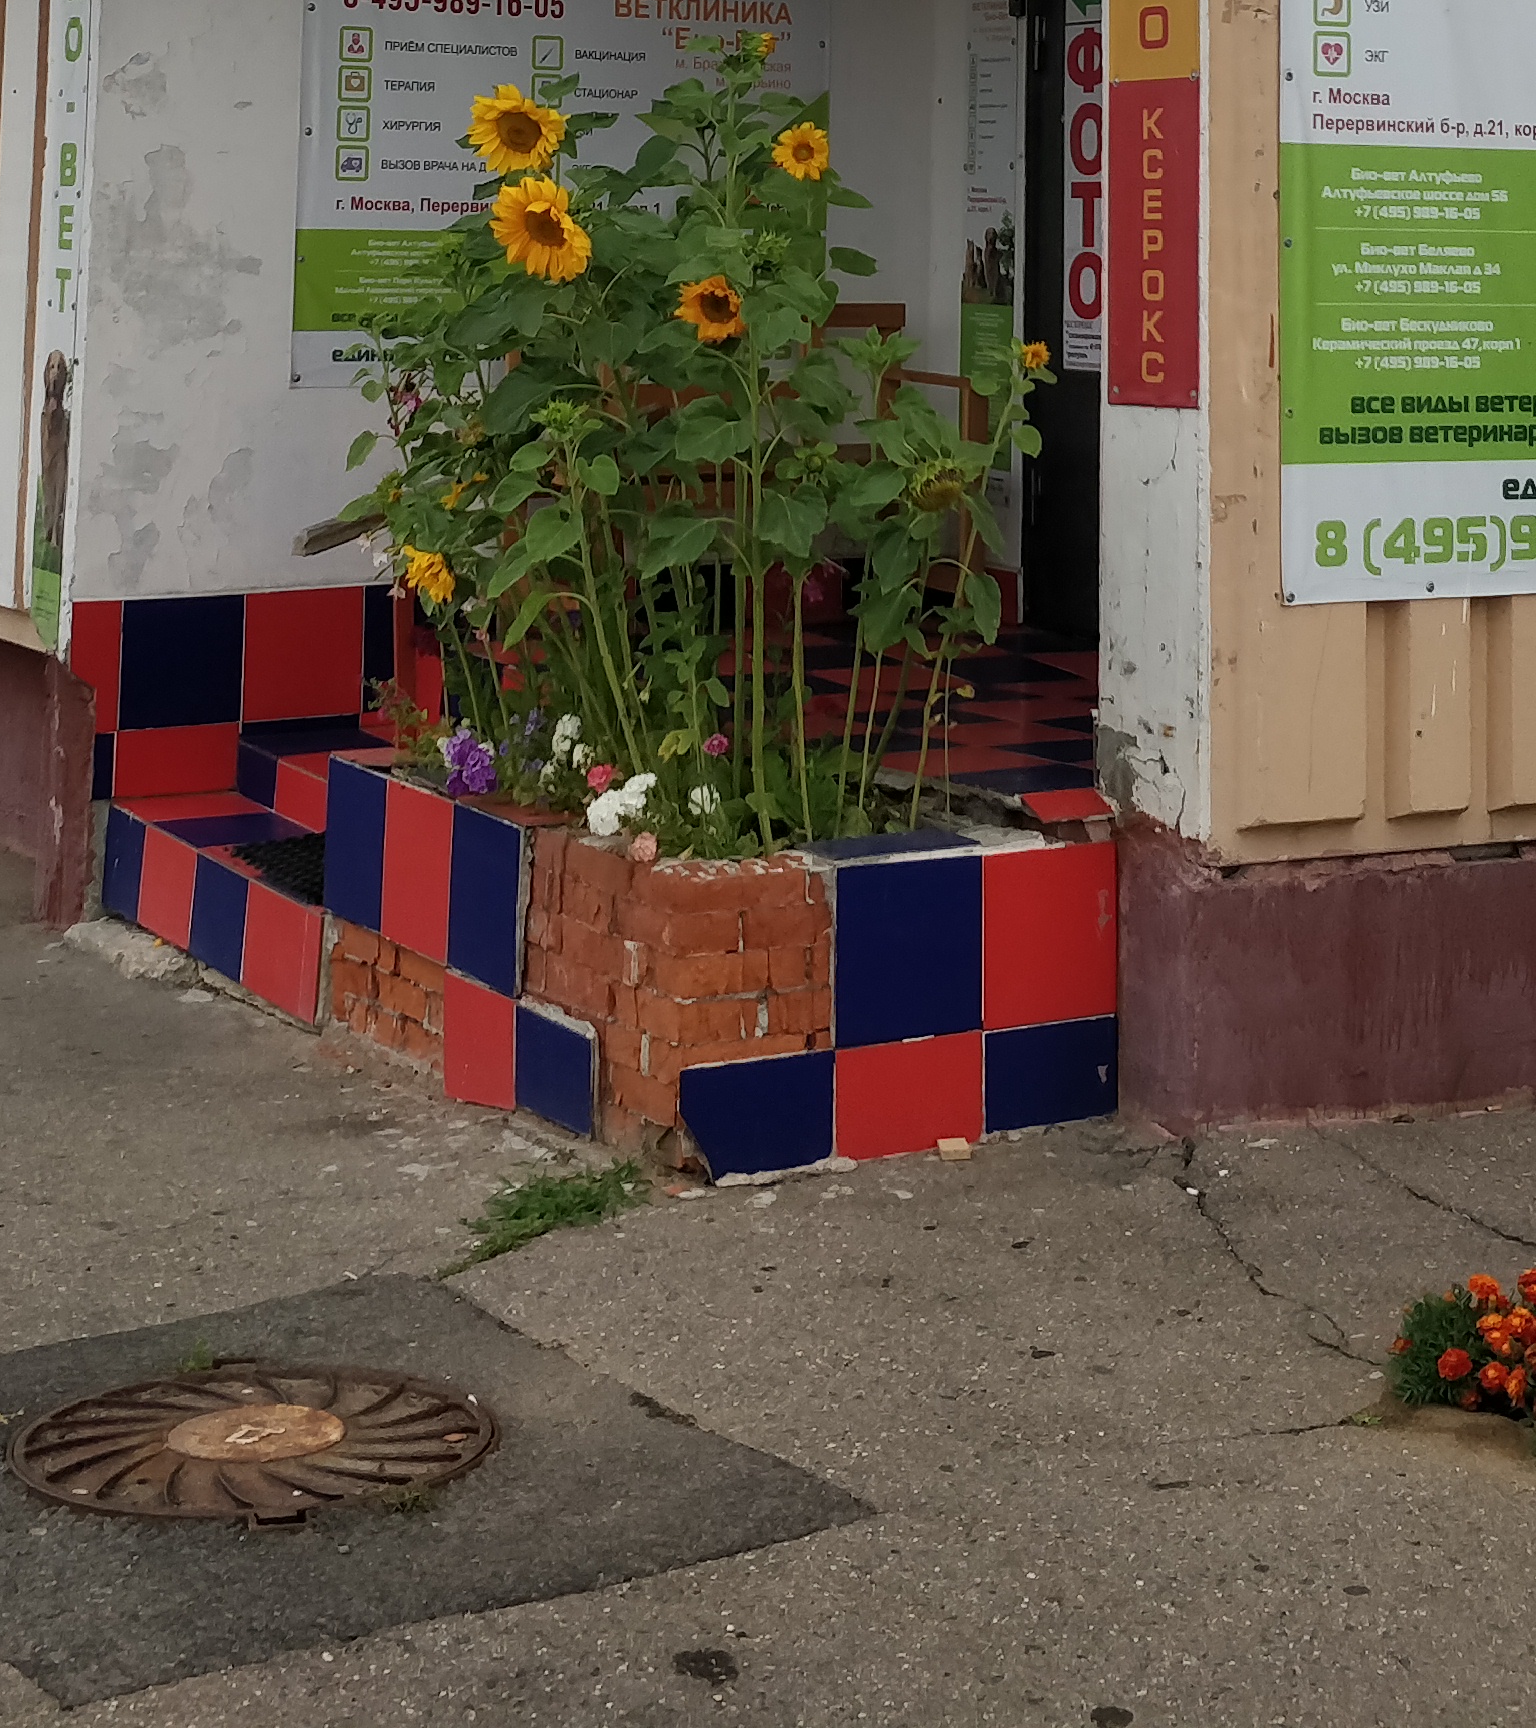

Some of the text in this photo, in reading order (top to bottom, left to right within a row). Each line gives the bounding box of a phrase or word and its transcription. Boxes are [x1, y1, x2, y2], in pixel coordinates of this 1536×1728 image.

[1364, 0, 1390, 14] УЗИ
[385, 39, 518, 58] ПРИЁМ СПЕЦИАЛИСТОВ
[575, 49, 646, 64] ВАКЦИНАЦИЯ
[1364, 49, 1389, 64] ЭКГ
[384, 79, 435, 93] ТЕРАПИЯ
[574, 87, 639, 100] СТАЦИОНАР
[1312, 87, 1391, 107] г. Москва
[382, 119, 441, 133] ХИРУРГИЯ
[1312, 112, 1435, 136] Перервинский
[1440, 117, 1470, 138] б-р,
[1473, 120, 1510, 140] д.21,
[381, 158, 421, 172] ВЫЗОВ
[423, 159, 459, 173] ВРАЧА
[461, 160, 476, 172] НА
[1066, 27, 1103, 320] ФОТО
[1351, 167, 1482, 185] Био-вет Алтуфьево
[1321, 185, 1421, 201] Алтуфьевское
[1423, 189, 1464, 202] шоссе
[335, 196, 416, 215] г. Москва,
[1354, 205, 1481, 221] +7 (495) 989-16-05
[1140, 107, 1165, 384] КСЕРОКС
[1360, 242, 1416, 257] Био-вет
[1332, 263, 1352, 276] ул.
[1355, 261, 1417, 277] Миклухо
[1483, 263, 1501, 276] 34
[1354, 279, 1481, 295] +7 (495) 989-16-05
[1340, 317, 1398, 332] Био-вет
[1354, 355, 1481, 371] +7 (495) 989-16-05
[1351, 393, 1396, 415] все
[1401, 392, 1470, 415] виды
[1319, 425, 1403, 445] вызов
[1314, 519, 1349, 568] 8
